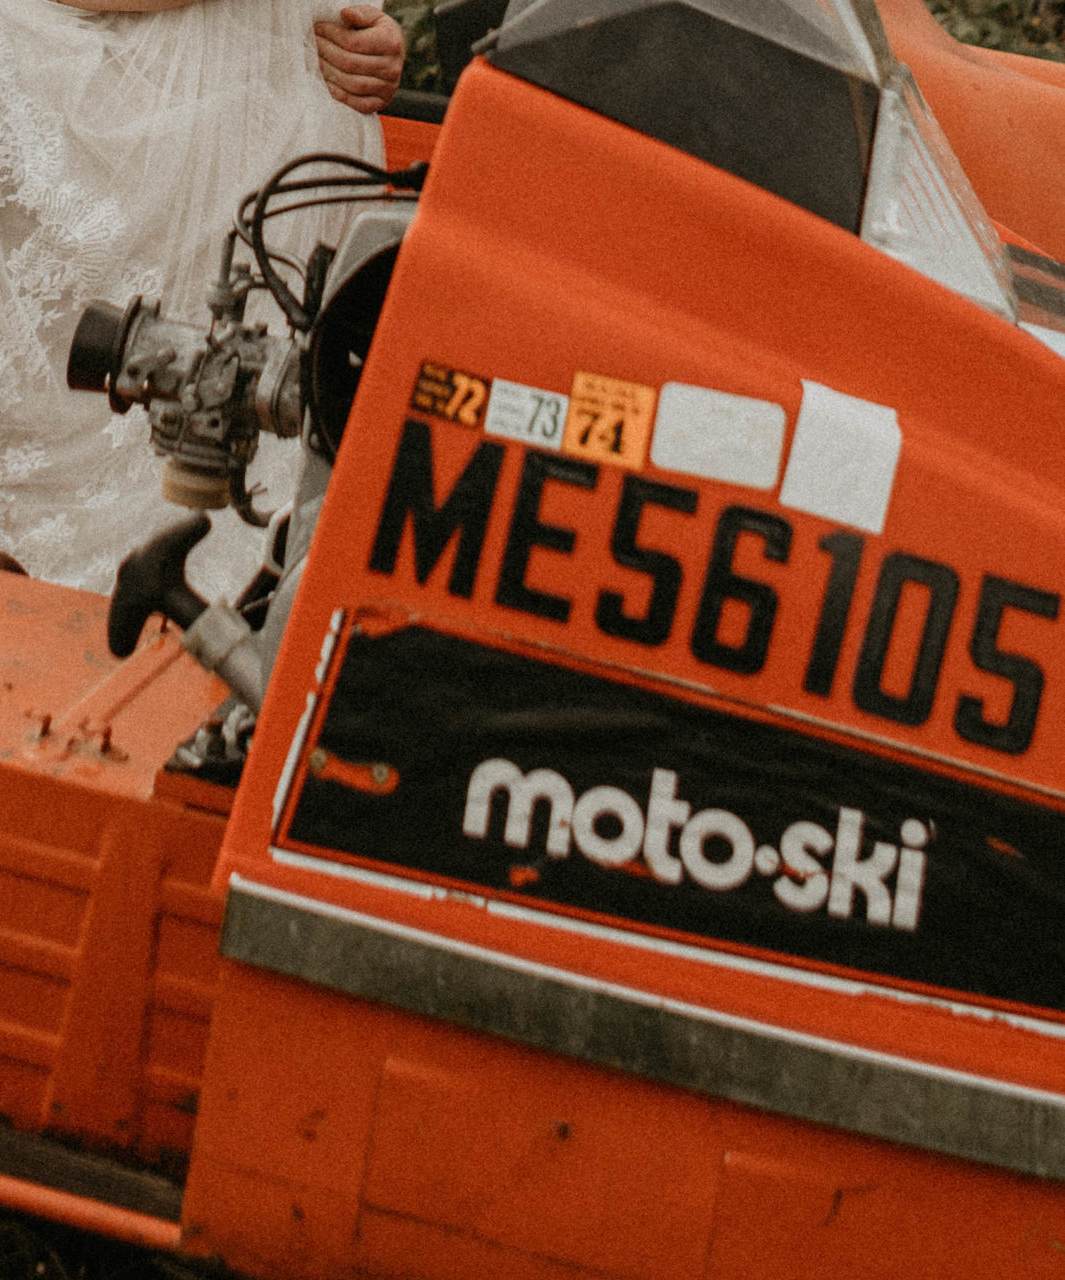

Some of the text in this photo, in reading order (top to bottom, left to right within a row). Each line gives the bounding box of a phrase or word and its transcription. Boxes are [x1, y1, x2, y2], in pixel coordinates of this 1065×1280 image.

[527, 393, 561, 438] 73
[576, 408, 625, 454] 74
[367, 419, 1062, 756] ME56105
